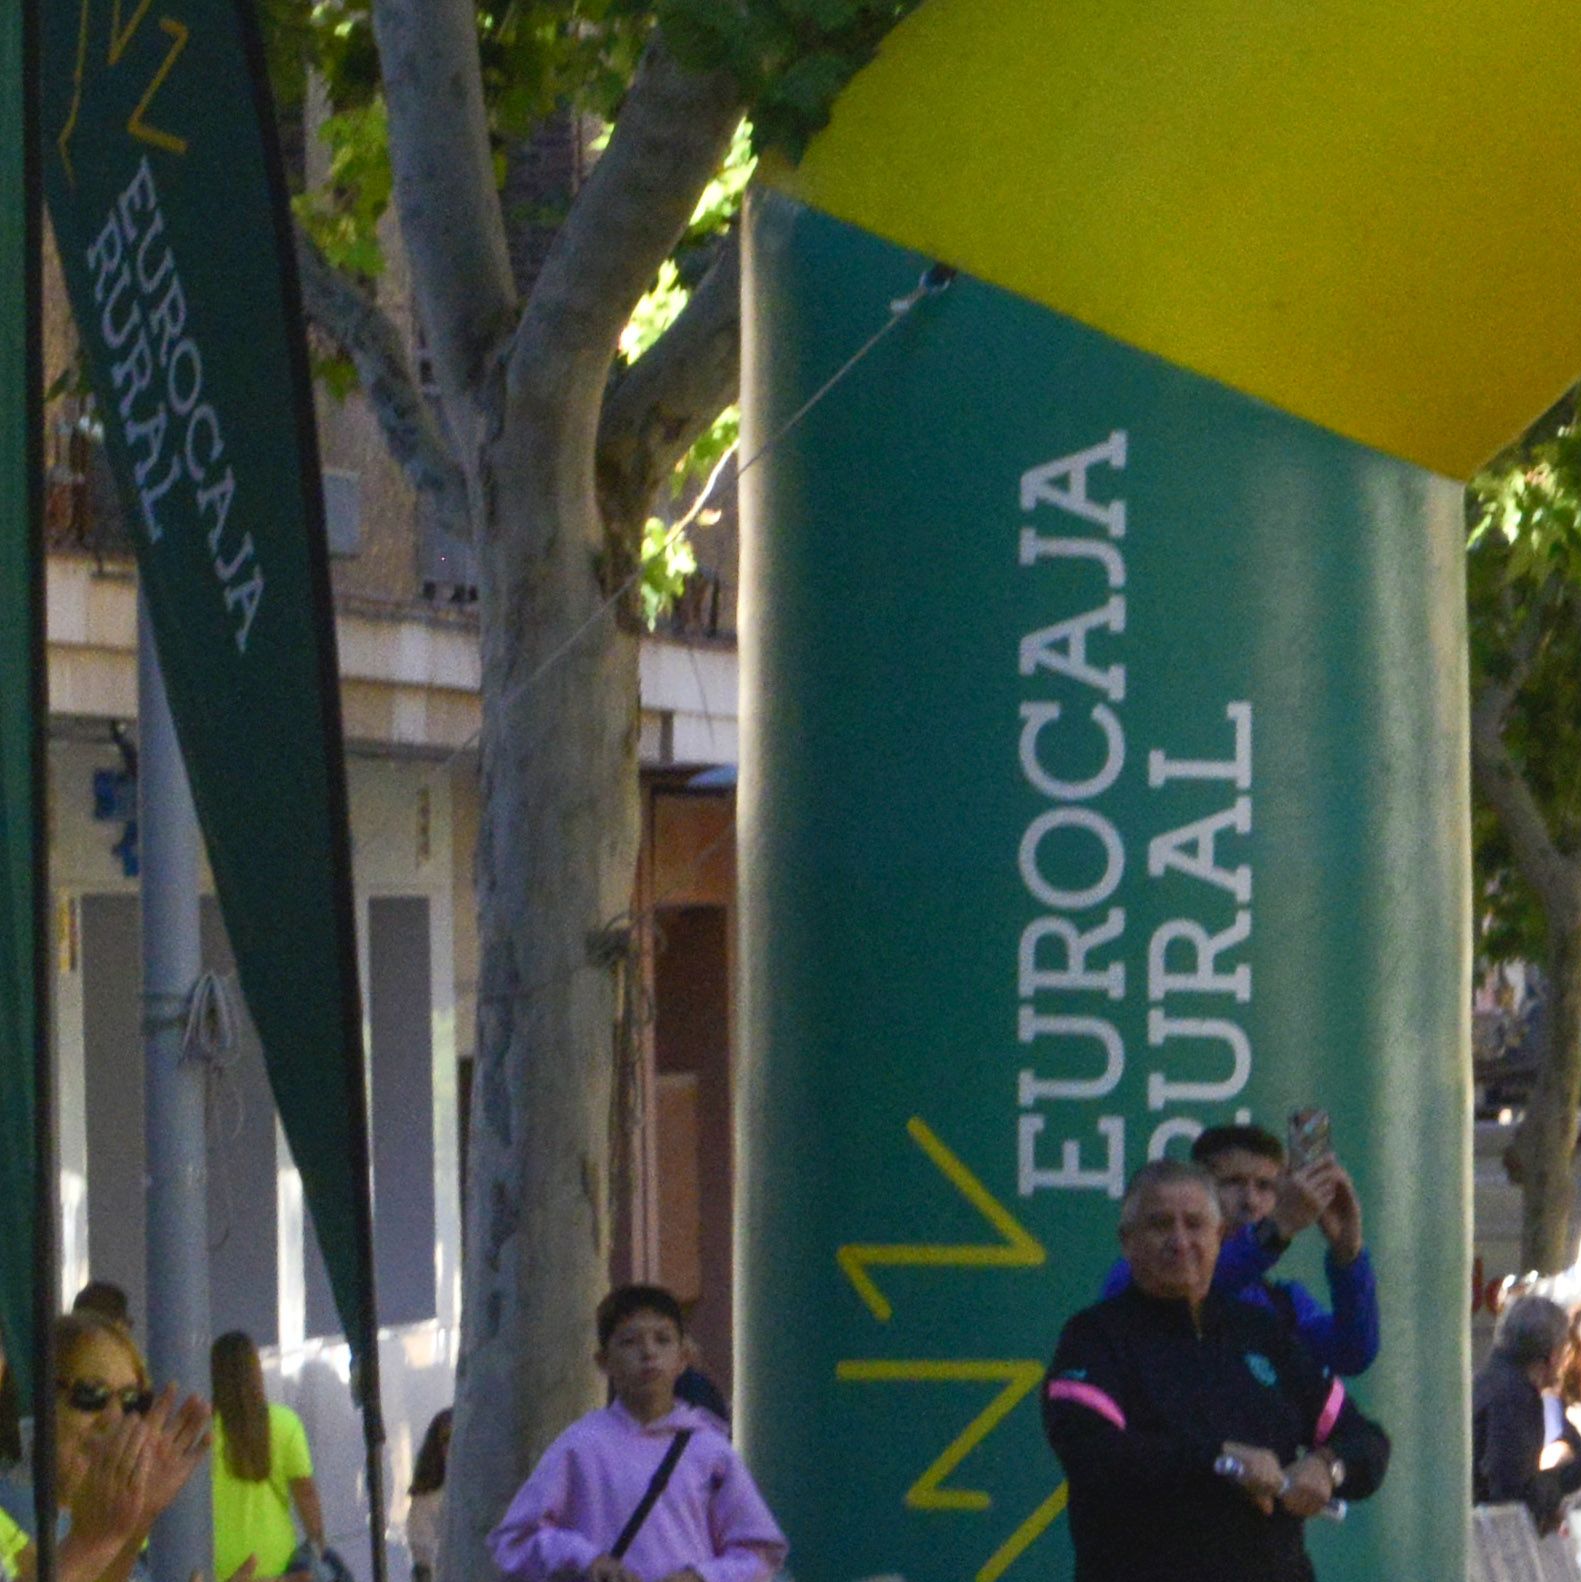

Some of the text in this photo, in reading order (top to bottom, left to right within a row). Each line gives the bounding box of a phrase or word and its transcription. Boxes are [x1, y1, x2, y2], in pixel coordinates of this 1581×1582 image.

[86, 209, 184, 545] RURAL
[117, 155, 265, 654] EUROCAJA
[1018, 430, 1128, 1198] EUROCAJA
